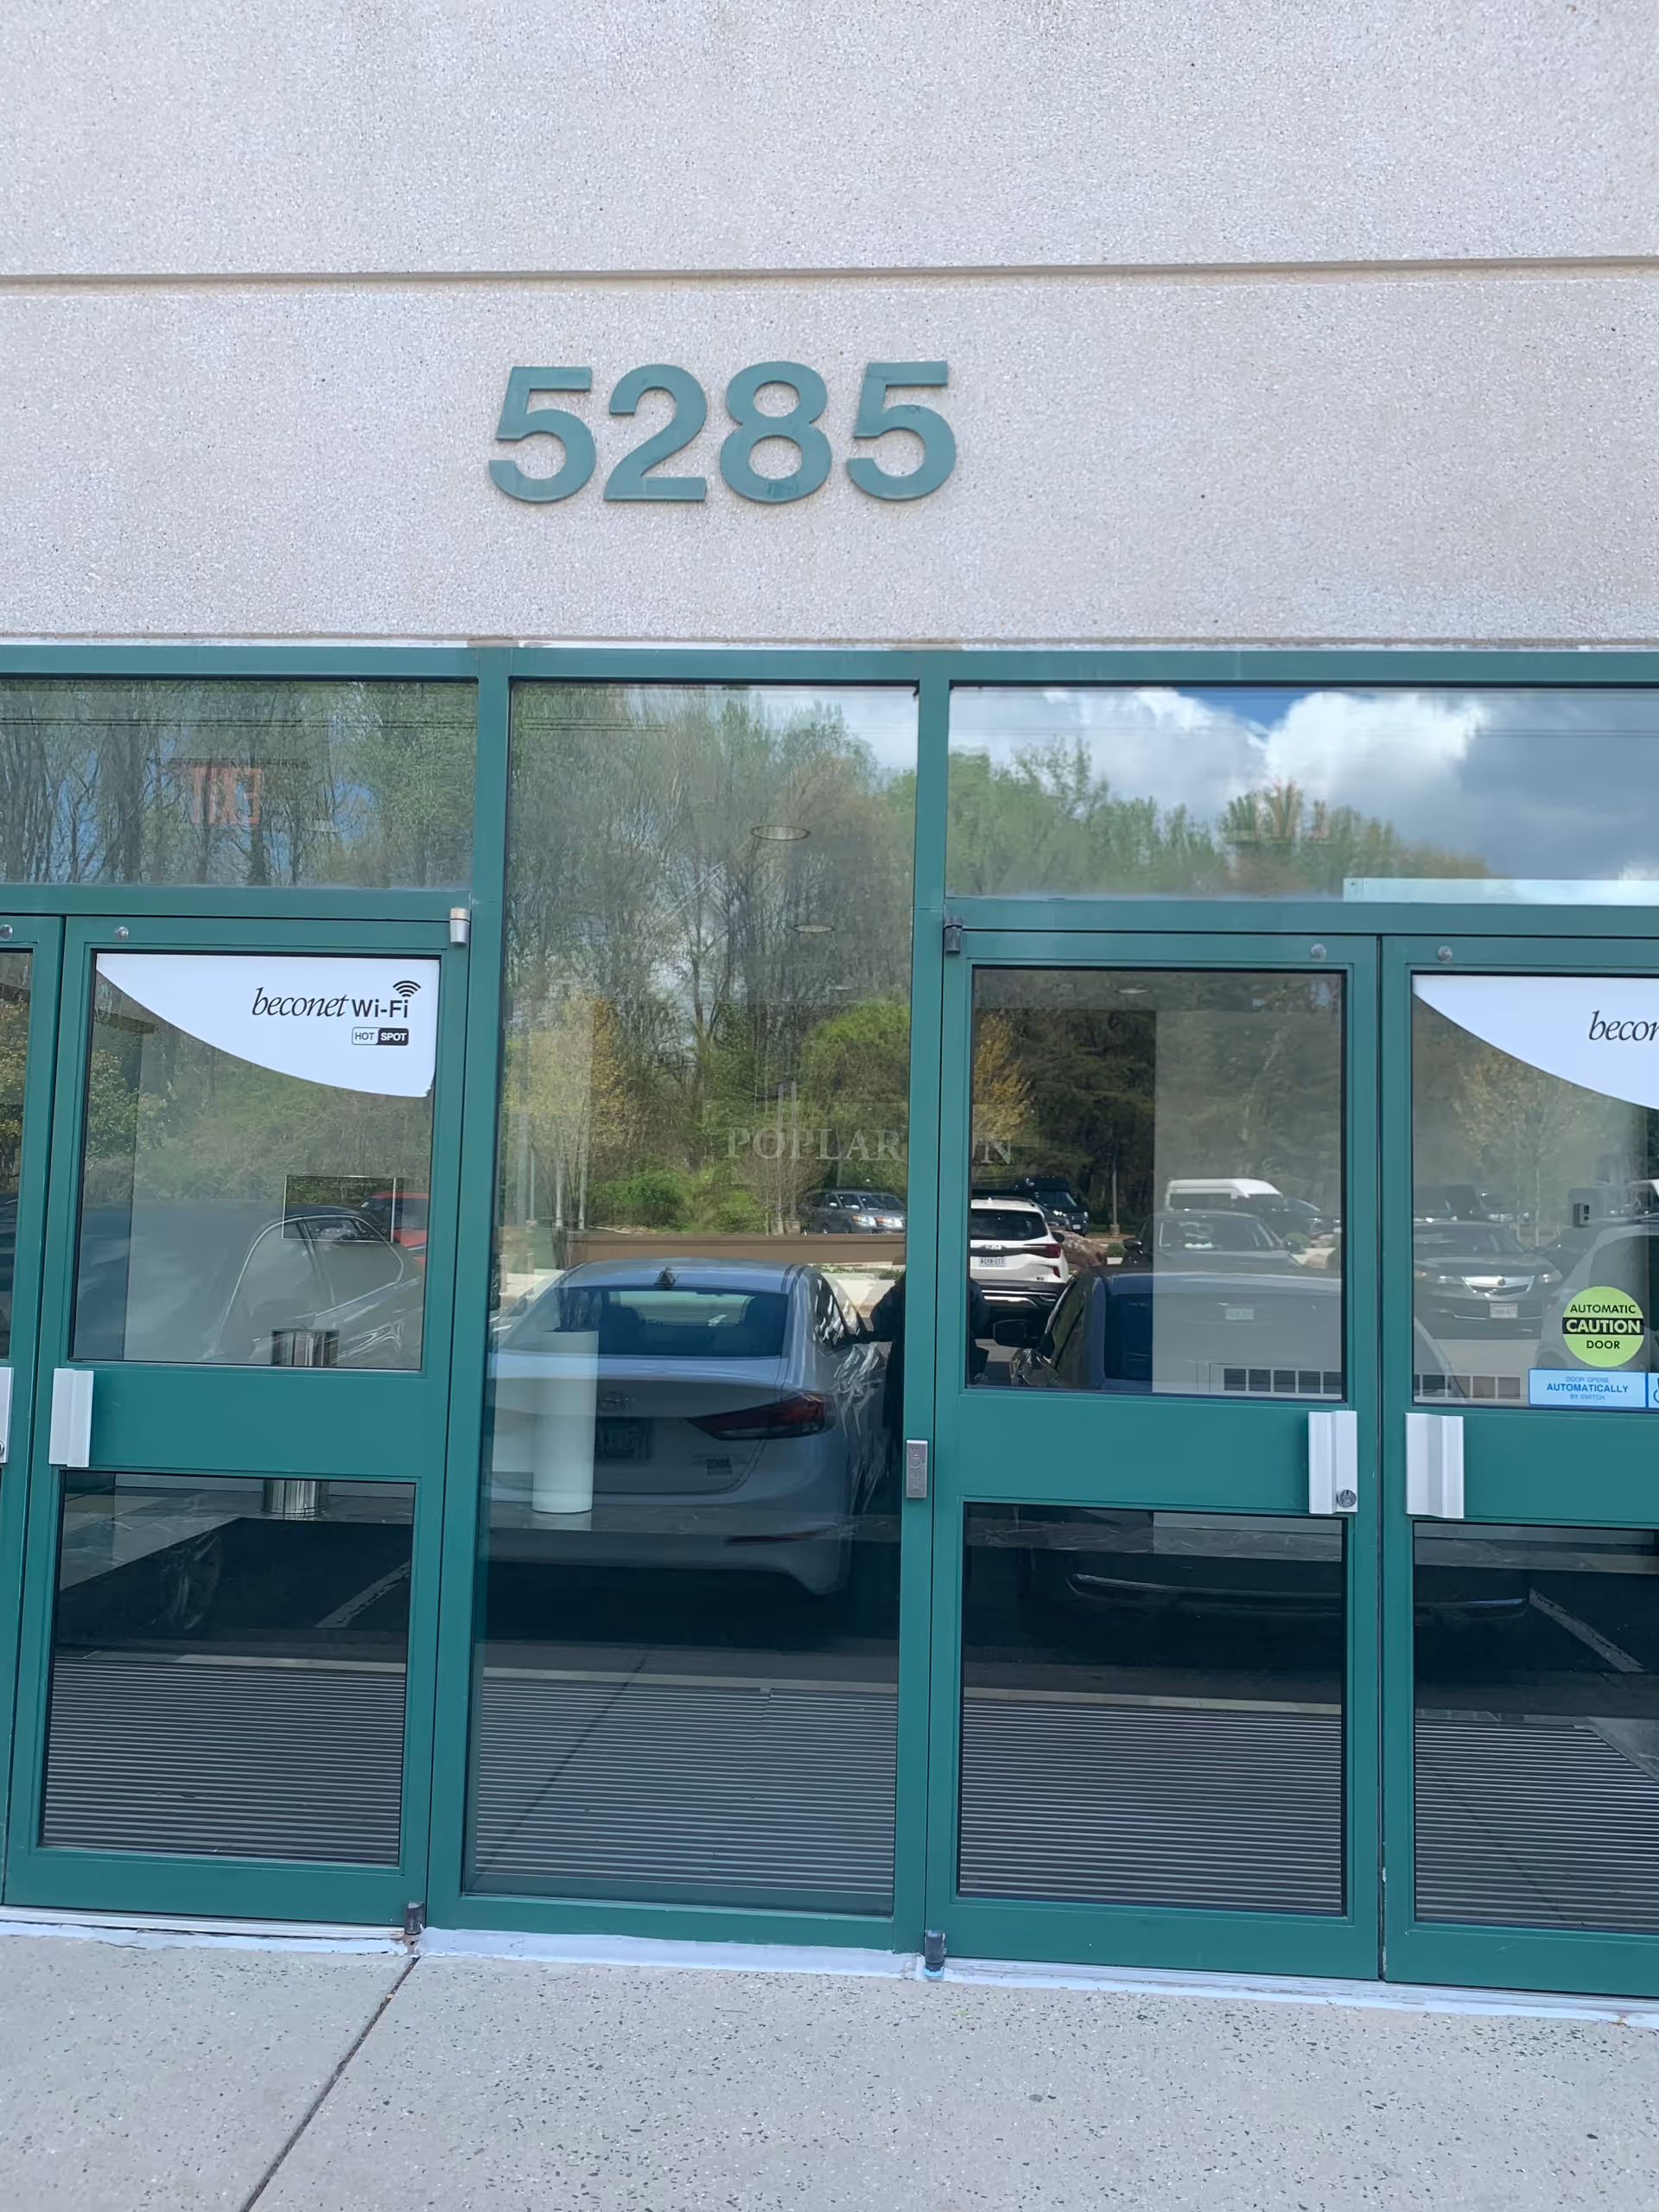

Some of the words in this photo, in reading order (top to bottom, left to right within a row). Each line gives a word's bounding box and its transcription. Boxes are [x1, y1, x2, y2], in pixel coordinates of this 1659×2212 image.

[488, 360, 957, 504] 5285
[251, 987, 349, 1017] beconet
[352, 999, 409, 1018] Wi-Fi
[354, 1032, 375, 1041] HOT
[380, 1032, 407, 1041] SPOT
[723, 1127, 906, 1161] POPLAR
[1570, 1305, 1636, 1314] AUTOMATIC
[1566, 1319, 1640, 1333] CAUTION
[1586, 1340, 1620, 1349] DOOR
[1547, 1383, 1628, 1393] AUTOMATICALLY
